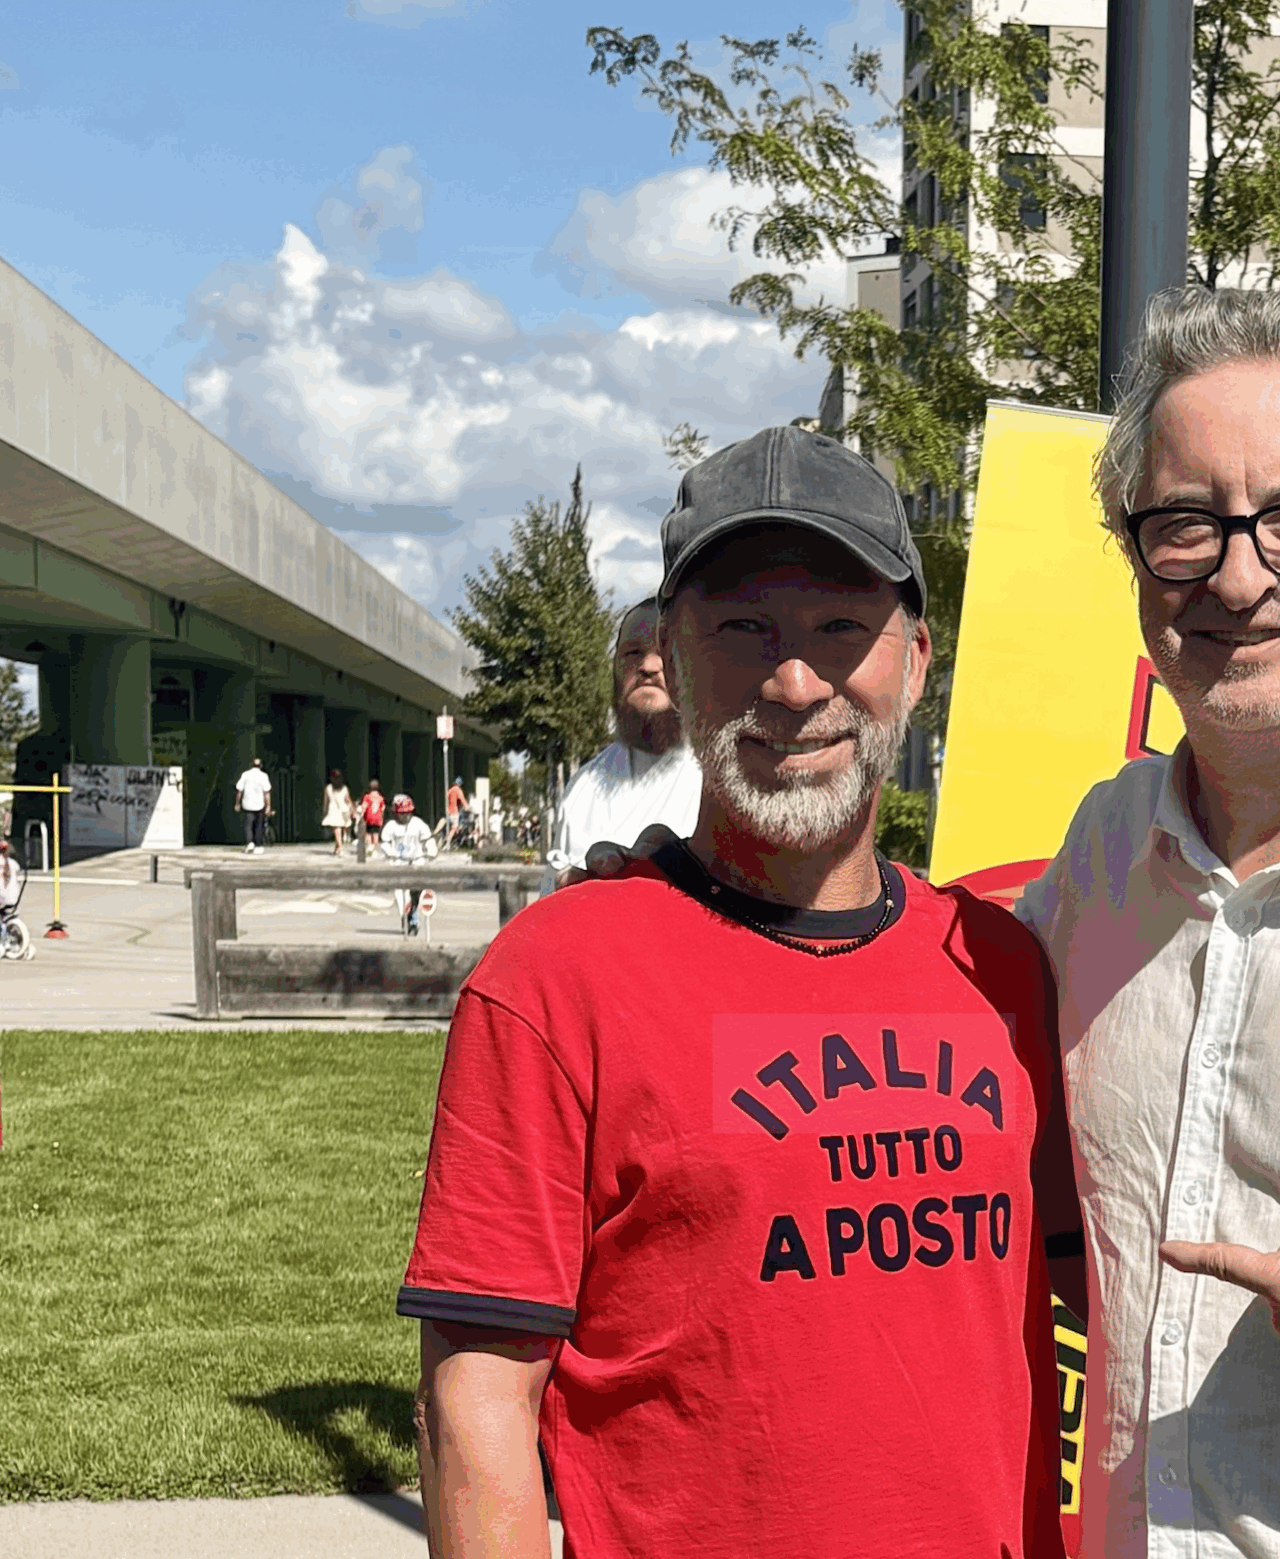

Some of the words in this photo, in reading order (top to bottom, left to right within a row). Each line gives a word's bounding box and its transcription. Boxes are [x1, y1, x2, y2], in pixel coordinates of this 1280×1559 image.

[730, 1028, 1004, 1141] ITALIA
[818, 1124, 963, 1183] TUTTO
[760, 1214, 817, 1282] A
[825, 1191, 1012, 1277] POSTO
